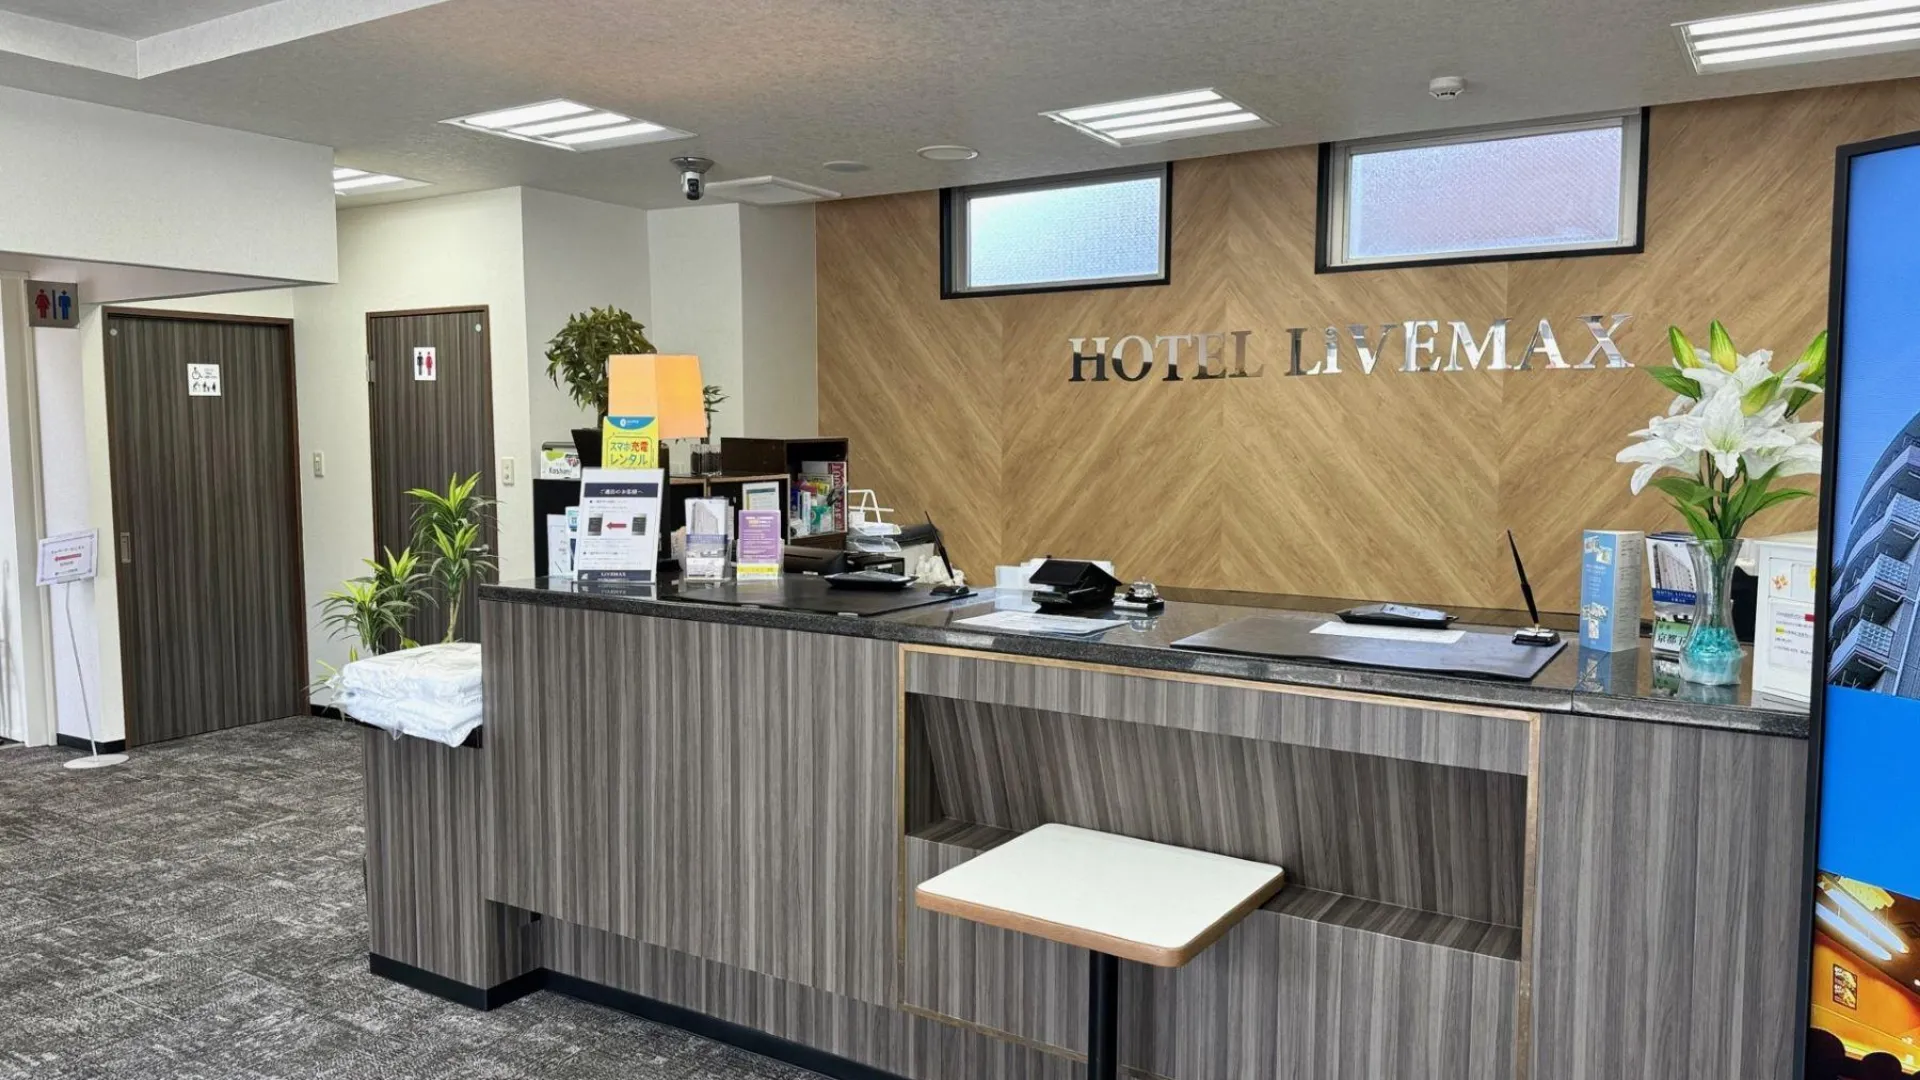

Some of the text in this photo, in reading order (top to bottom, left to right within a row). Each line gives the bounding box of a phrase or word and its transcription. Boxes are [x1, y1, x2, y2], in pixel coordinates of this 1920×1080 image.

[1068, 330, 1264, 382] HOTEL
[610, 441, 648, 452] スマホ充電
[610, 454, 648, 465] レンタル
